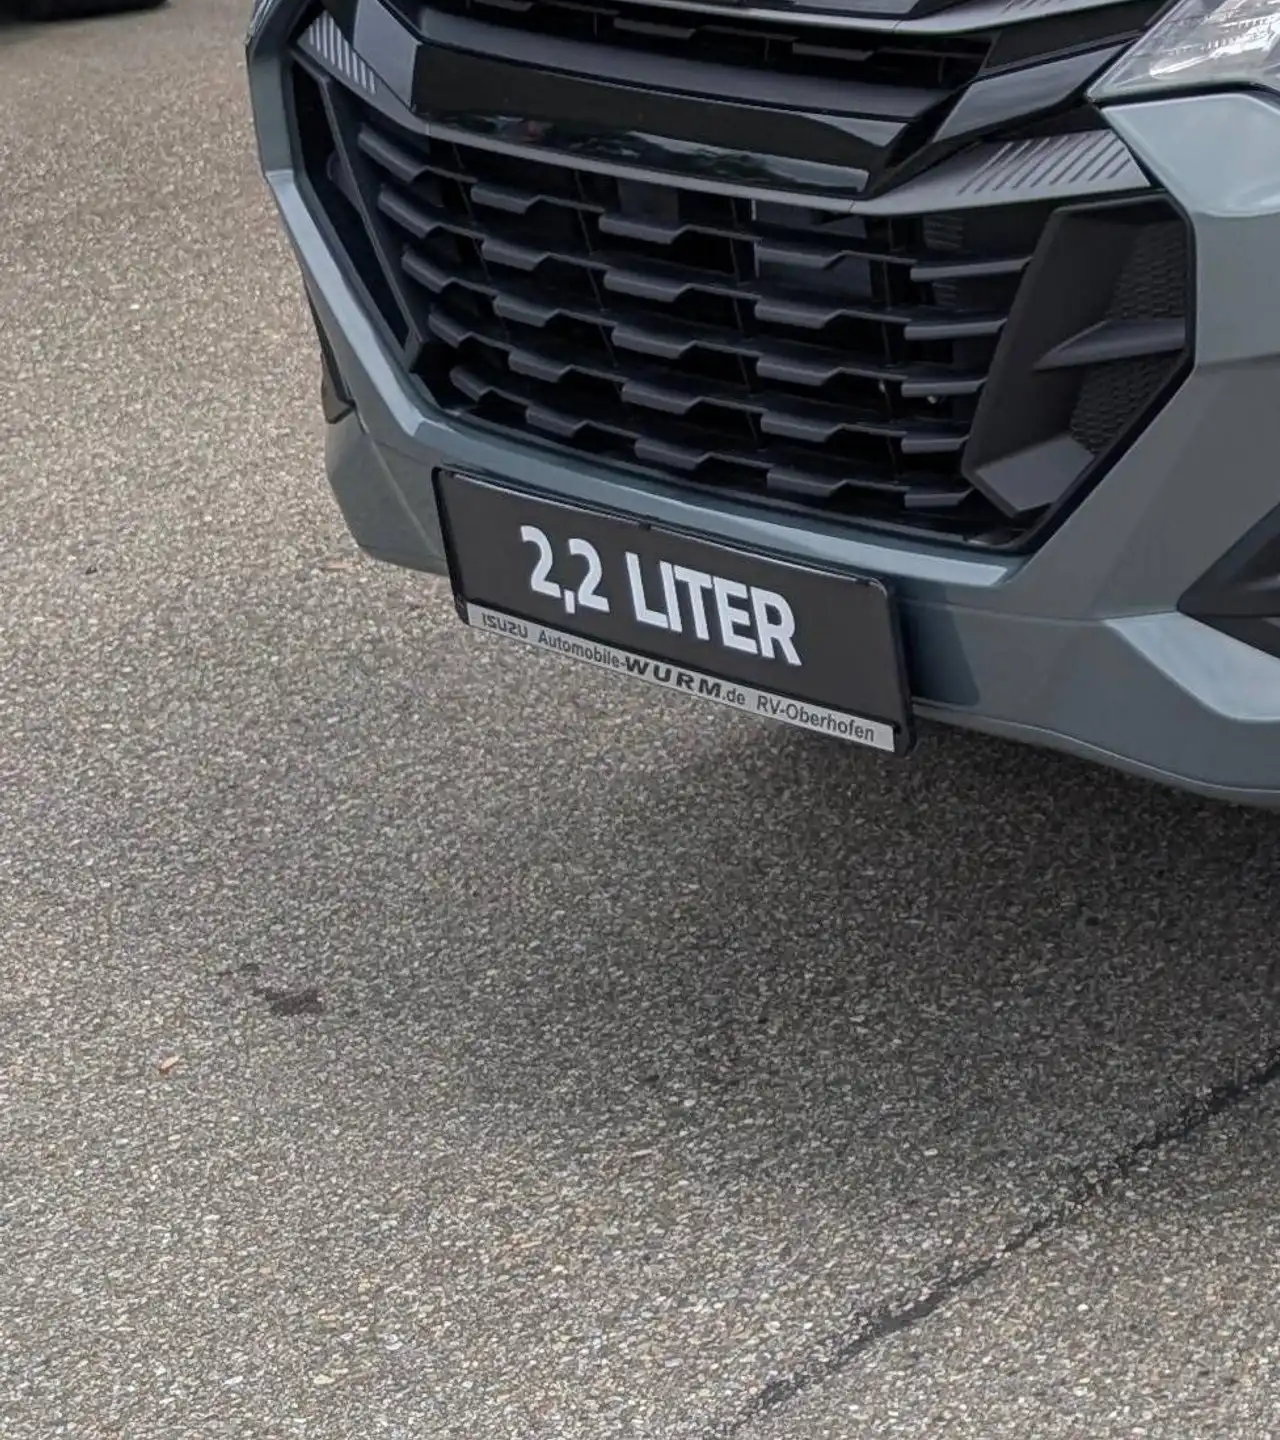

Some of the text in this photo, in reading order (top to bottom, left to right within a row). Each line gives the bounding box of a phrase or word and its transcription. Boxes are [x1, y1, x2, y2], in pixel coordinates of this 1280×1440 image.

[520, 524, 802, 666] 2,2 LITER
[482, 612, 528, 639] ISUZU
[756, 694, 875, 742] RV-Oberhofen
